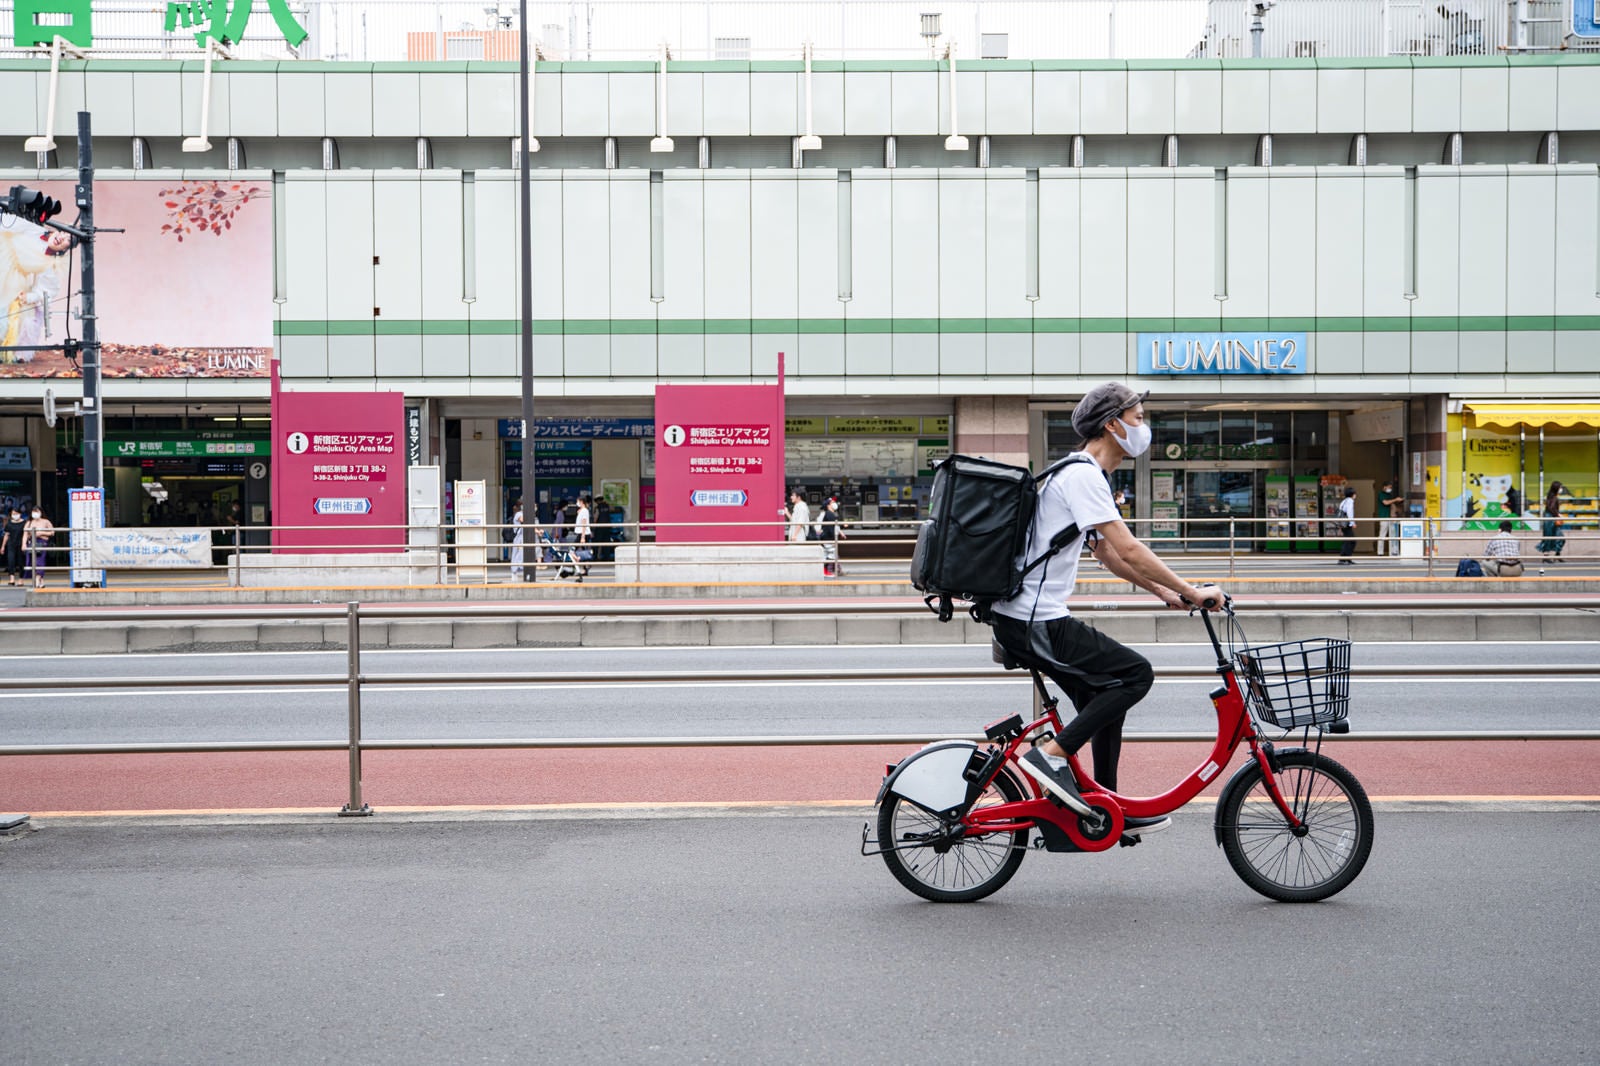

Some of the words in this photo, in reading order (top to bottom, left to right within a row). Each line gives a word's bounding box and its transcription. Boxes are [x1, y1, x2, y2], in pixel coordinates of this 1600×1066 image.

[1152, 339, 1297, 371] LUMINE2
[208, 354, 266, 369] LUMINE
[690, 428, 769, 437] 新宿区エリアマップ
[313, 435, 393, 444] 新宿区エリアマップ
[721, 438, 735, 446] City
[754, 438, 769, 446] Map
[118, 441, 135, 452] JR
[313, 445, 344, 453] Shinjuku
[344, 445, 359, 453] City
[377, 445, 393, 453] Map
[371, 465, 386, 473] 38-2
[333, 474, 358, 482] Shinjuku
[358, 474, 370, 482] City
[71, 492, 100, 500] お知らせ
[698, 493, 739, 504] 甲州街道
[321, 501, 364, 512] 甲州街道
